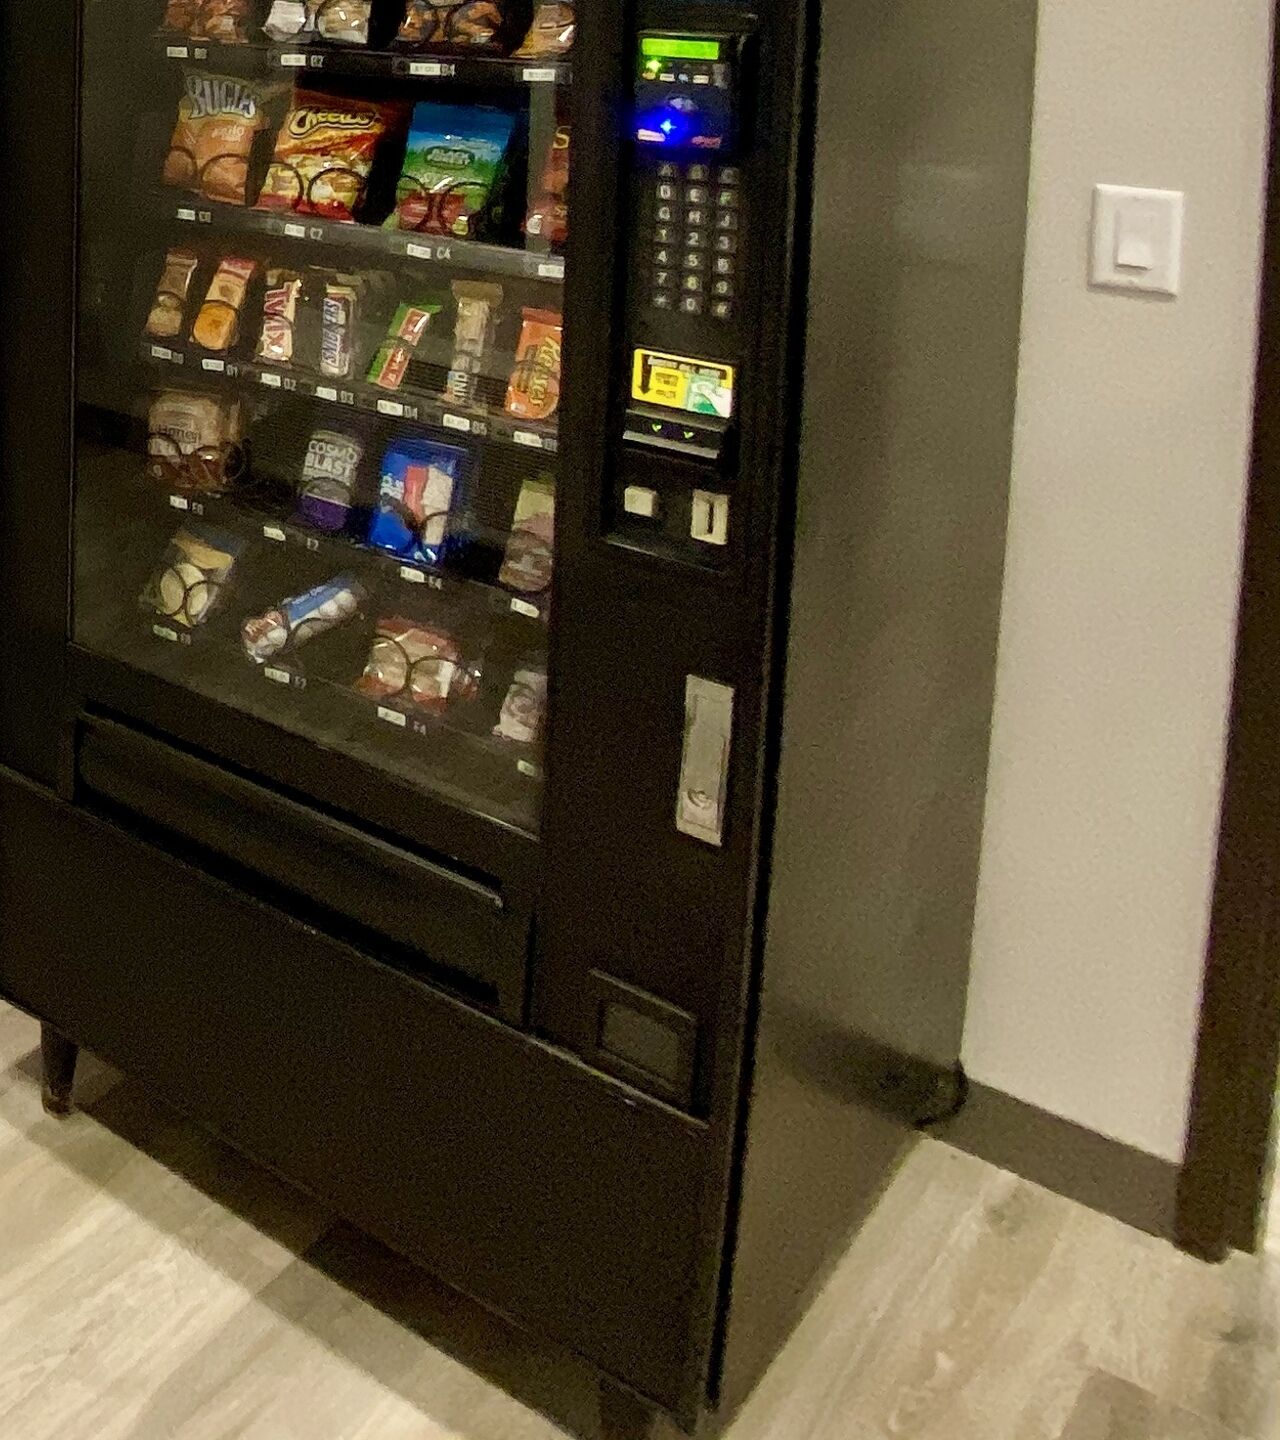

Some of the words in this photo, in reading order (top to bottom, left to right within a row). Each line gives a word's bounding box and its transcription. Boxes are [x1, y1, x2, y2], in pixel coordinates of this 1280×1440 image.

[661, 228, 668, 241] 1
[688, 232, 699, 246] 2
[718, 235, 730, 250] 3
[658, 250, 668, 262] 4
[689, 254, 699, 267] 5
[657, 272, 668, 284] 7
[687, 275, 699, 290] 8
[716, 280, 728, 294] 9
[308, 440, 358, 462] COSMO
[304, 453, 354, 478] BLAST
